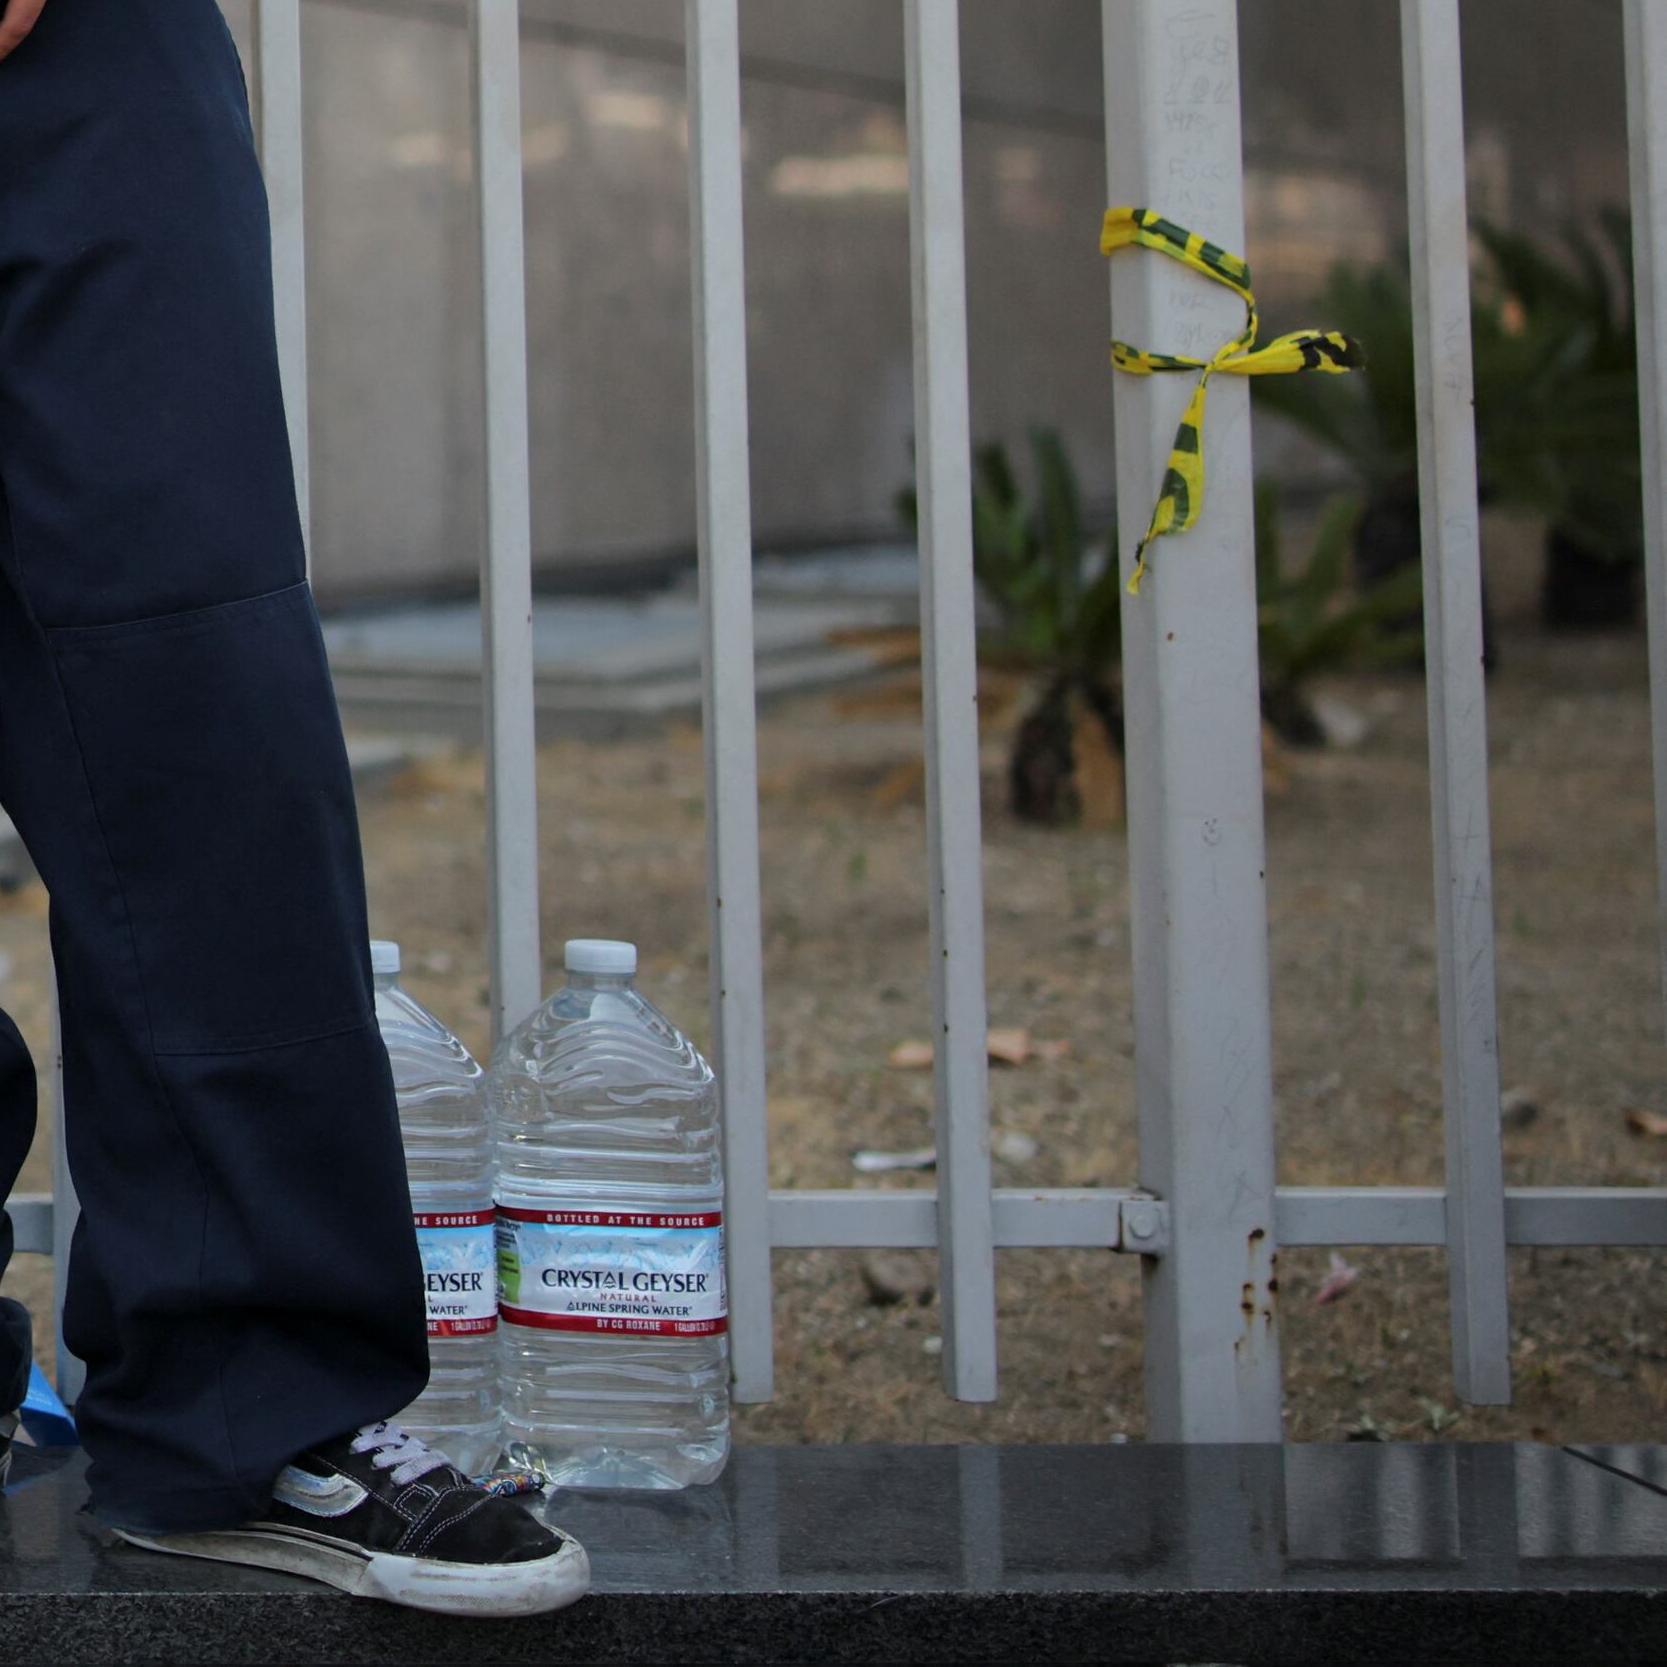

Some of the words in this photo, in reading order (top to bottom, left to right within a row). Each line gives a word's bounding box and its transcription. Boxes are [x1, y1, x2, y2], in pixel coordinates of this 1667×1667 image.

[436, 1215, 478, 1225] SOURCE
[546, 1214, 600, 1224] BOTTLED
[608, 1215, 622, 1224] AT
[630, 1216, 652, 1225] THE
[659, 1217, 705, 1226] SOURCE
[426, 1272, 483, 1292] EYSER
[541, 1268, 629, 1290] CRYSTAL
[600, 1292, 658, 1303] NATURAL
[567, 1301, 607, 1313] ALPINE
[609, 1303, 649, 1315] SPRING
[597, 1318, 608, 1328] BY
[626, 1320, 661, 1330] ROXANE
